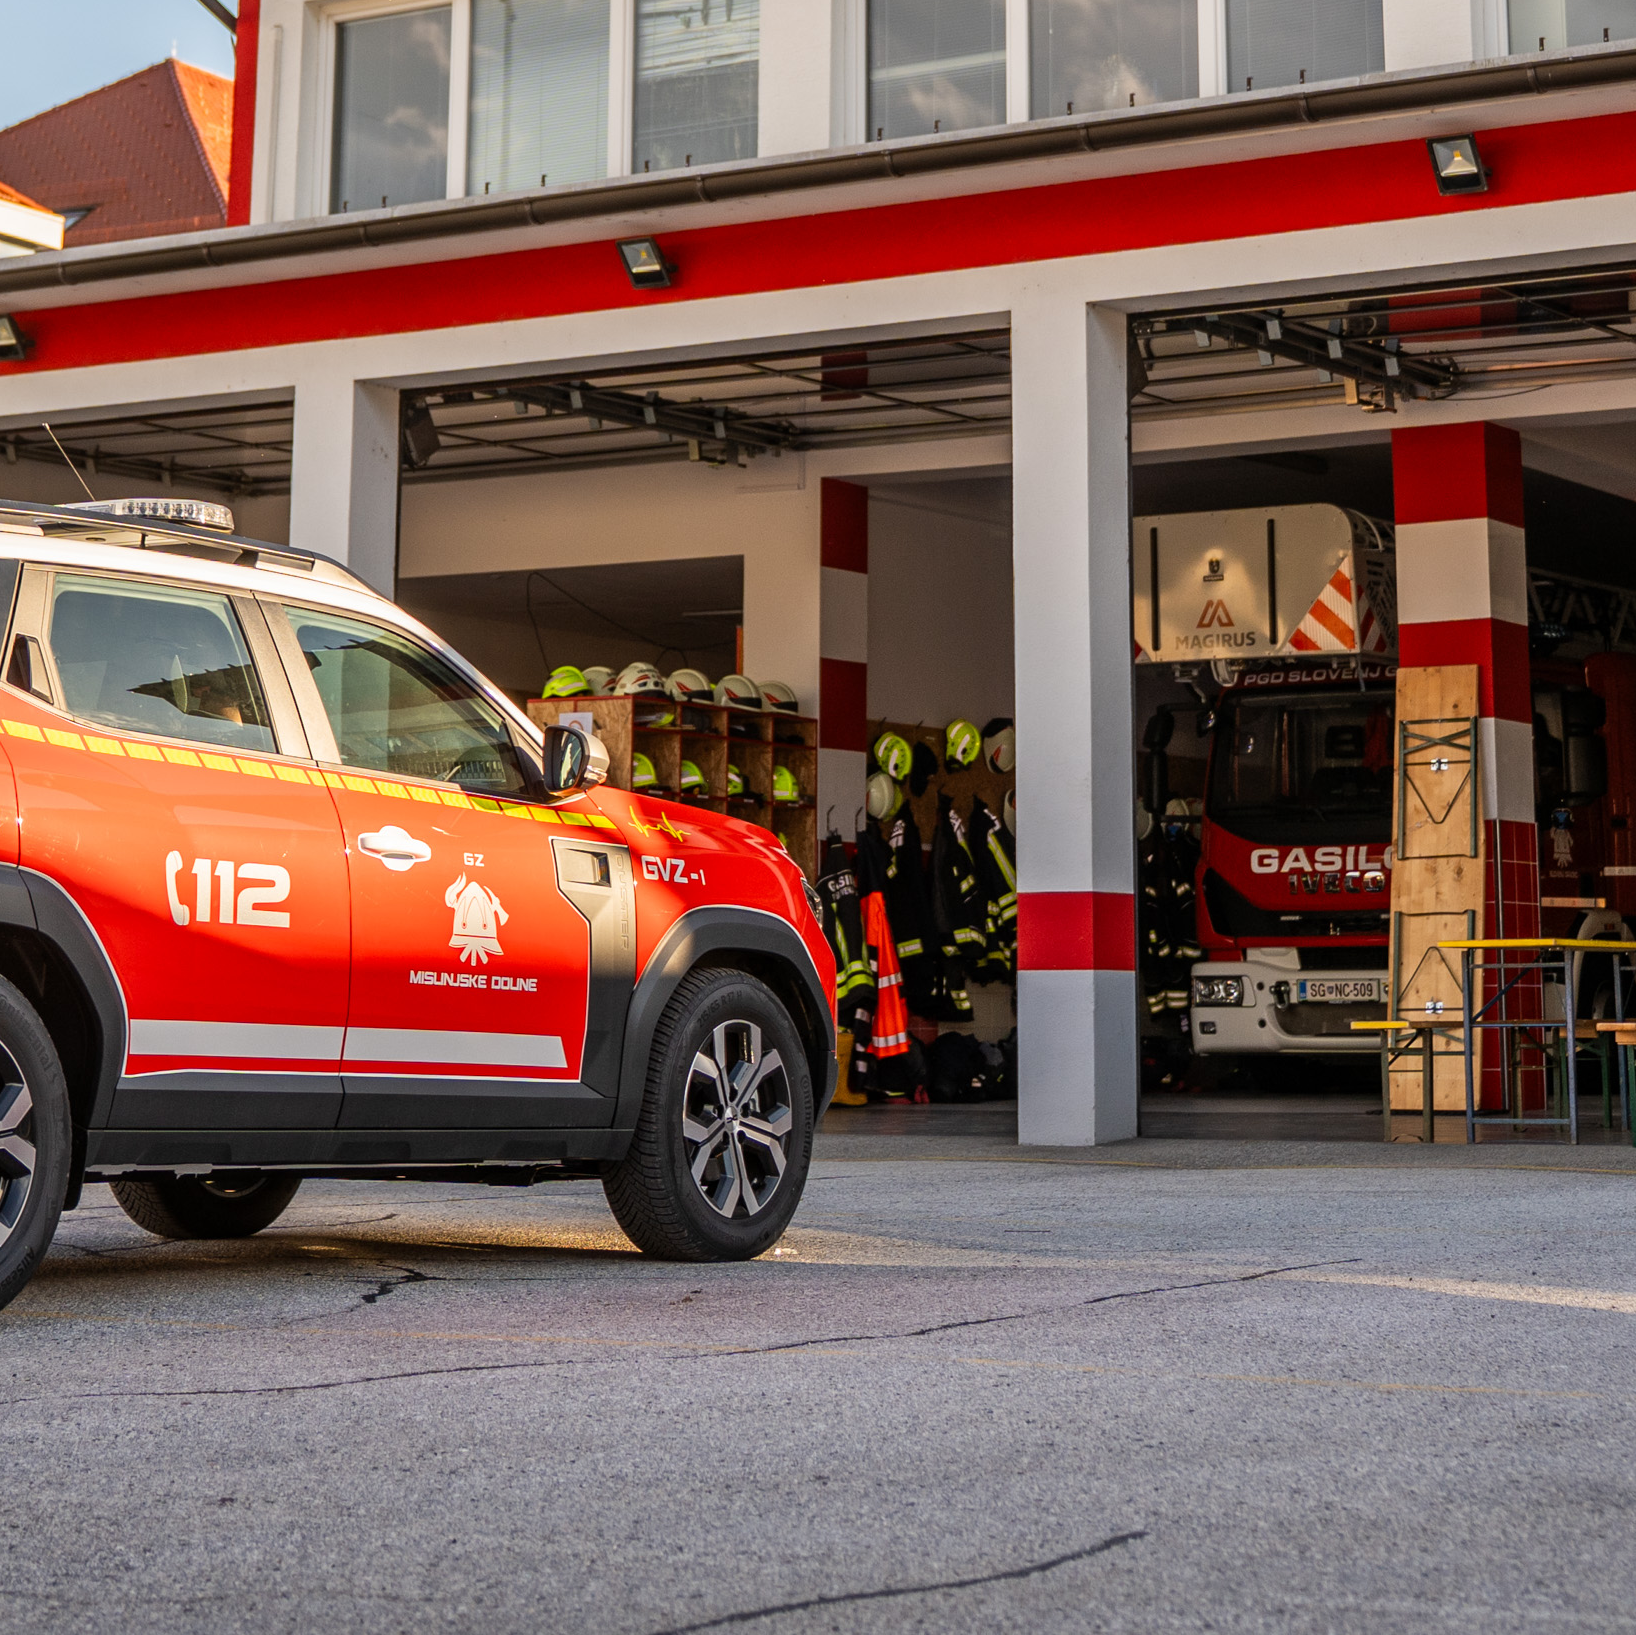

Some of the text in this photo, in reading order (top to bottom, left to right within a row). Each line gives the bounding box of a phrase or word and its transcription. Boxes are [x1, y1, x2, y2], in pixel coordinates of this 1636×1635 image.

[1174, 631, 1256, 650] MAGIRUS
[1243, 672, 1284, 686] PGD
[463, 852, 485, 867] GZ
[191, 857, 291, 928] 112
[1288, 871, 1386, 895] IVECO
[409, 970, 538, 992] MISLINJSKE DOLINE
[1310, 982, 1373, 997] SG NC-509
[800, 1073, 815, 1161] Continental
